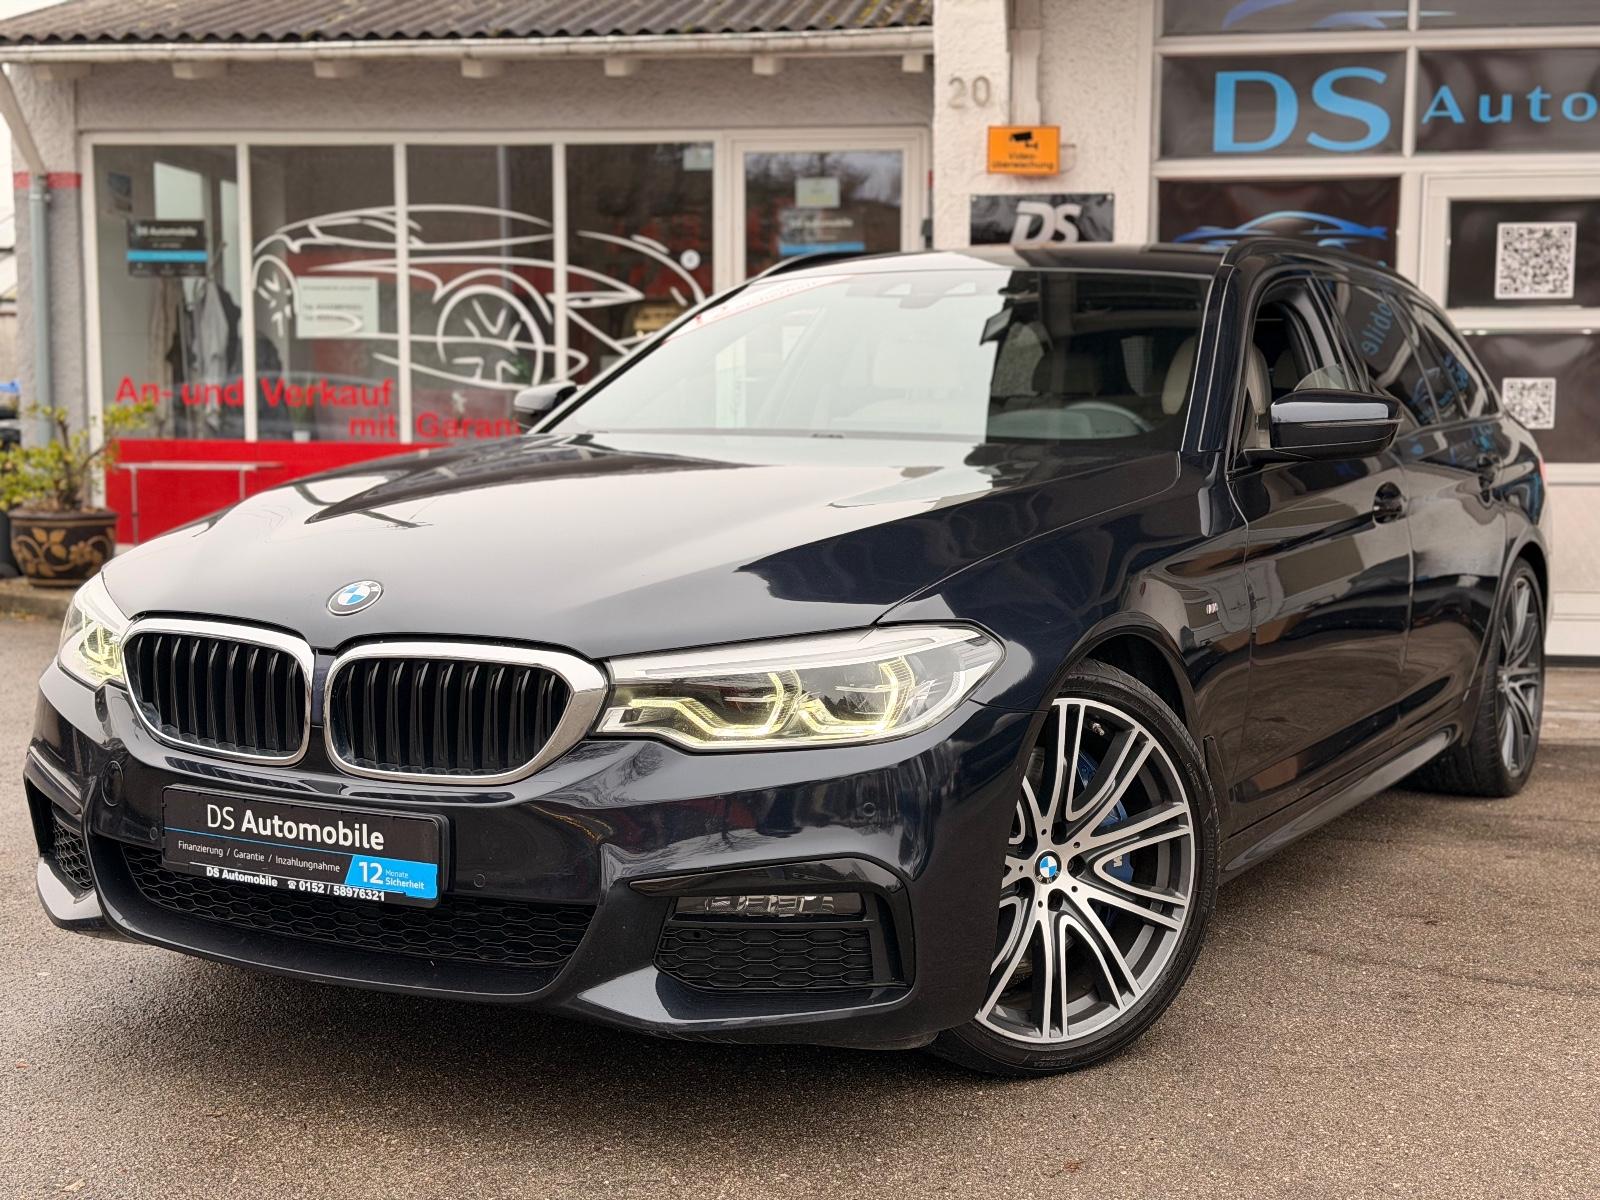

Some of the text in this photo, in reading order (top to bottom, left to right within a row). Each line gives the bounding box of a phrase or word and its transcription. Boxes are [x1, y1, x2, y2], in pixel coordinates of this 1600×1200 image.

[948, 75, 991, 110] 20
[1213, 66, 1598, 153] DS Auto
[1010, 200, 1083, 246] DS
[116, 376, 393, 408] An- und Verkauf
[350, 412, 398, 439] mit
[207, 803, 385, 851] DS Automobile
[178, 840, 224, 858] Finanzierung
[233, 848, 265, 863] Garantie
[275, 855, 341, 874] Inzahlungnahme
[358, 861, 384, 885] 12
[385, 869, 409, 879] Monate
[206, 866, 220, 878] DS
[221, 869, 278, 888] Automobile
[299, 880, 325, 894] 0152
[333, 885, 385, 902] 58976321
[385, 876, 425, 890] Sicherheit
